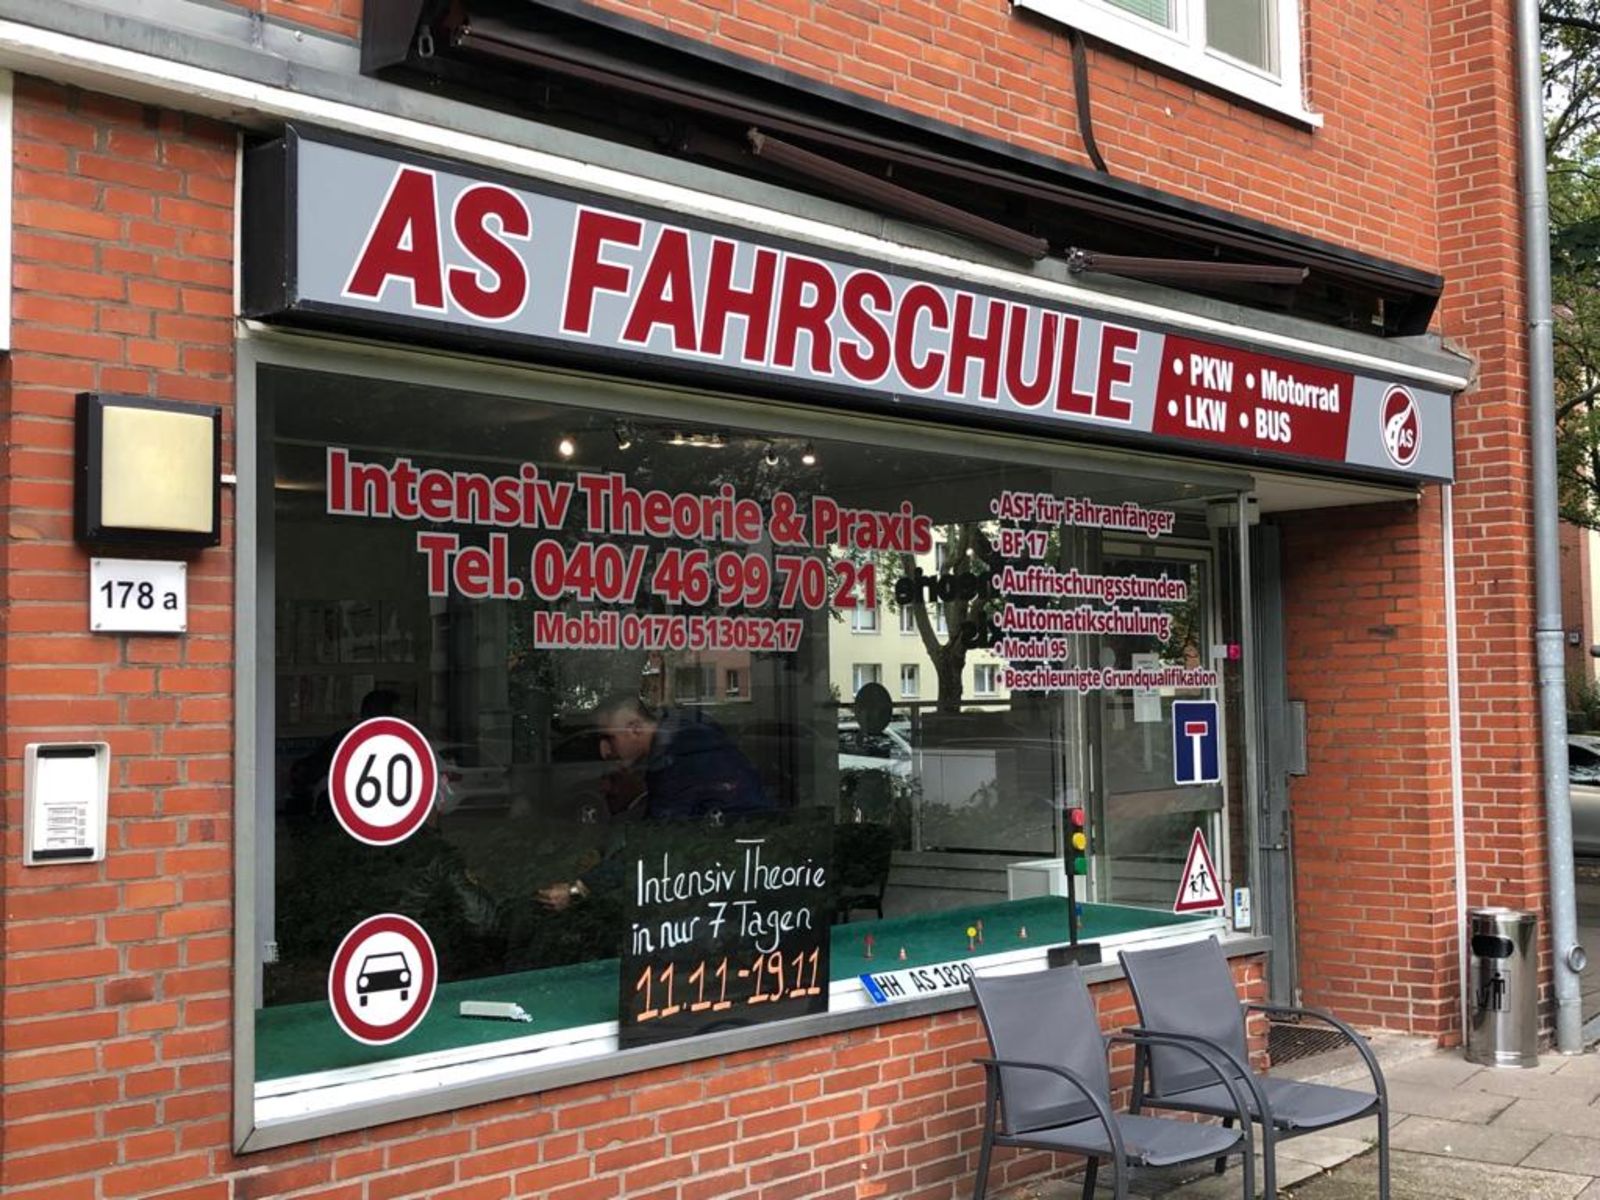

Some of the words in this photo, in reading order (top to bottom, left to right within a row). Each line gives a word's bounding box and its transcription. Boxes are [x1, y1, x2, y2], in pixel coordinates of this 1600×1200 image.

[342, 163, 531, 323] AS
[560, 205, 1140, 424] FAHRSCHULE
[1190, 354, 1233, 392] PKW
[1261, 369, 1339, 413] Motorrad
[1185, 395, 1227, 432] LKW
[1255, 407, 1291, 443] BUS
[1399, 428, 1413, 448] AS
[327, 447, 574, 530] Intensiv
[578, 473, 763, 543] Theorie
[769, 492, 811, 547] &
[812, 496, 933, 555] Praxis
[1000, 491, 1034, 519] ASF
[1035, 495, 1062, 522] für
[1064, 498, 1175, 538] Fahranfänger
[1001, 530, 1025, 557] BF
[1026, 531, 1049, 558] 17
[417, 531, 523, 598] Tel.
[531, 538, 648, 604] 040/
[652, 548, 711, 605] 46
[715, 552, 771, 607] 99
[775, 555, 827, 609] 70
[829, 560, 877, 609] 21
[1002, 566, 1187, 601] Auffrischungsstunden
[100, 580, 154, 609] 178
[163, 591, 178, 610] a
[534, 611, 620, 649] Mobil
[622, 615, 687, 649] 0176
[689, 616, 803, 651] 51305217
[1003, 605, 1171, 641] Automatikschulung
[1003, 637, 1048, 659] Modul
[1049, 639, 1067, 659] 95
[1005, 666, 1101, 694] Beschleunigte
[1102, 668, 1218, 691] Grundqualifikation
[355, 753, 412, 808] 60
[637, 852, 735, 906] Intensiv
[735, 838, 826, 892] Theorie
[632, 923, 655, 955] in
[660, 916, 700, 949] nur
[708, 902, 727, 938] 7
[733, 900, 812, 953] Tagen
[874, 974, 906, 997] HH
[909, 969, 937, 992] AS
